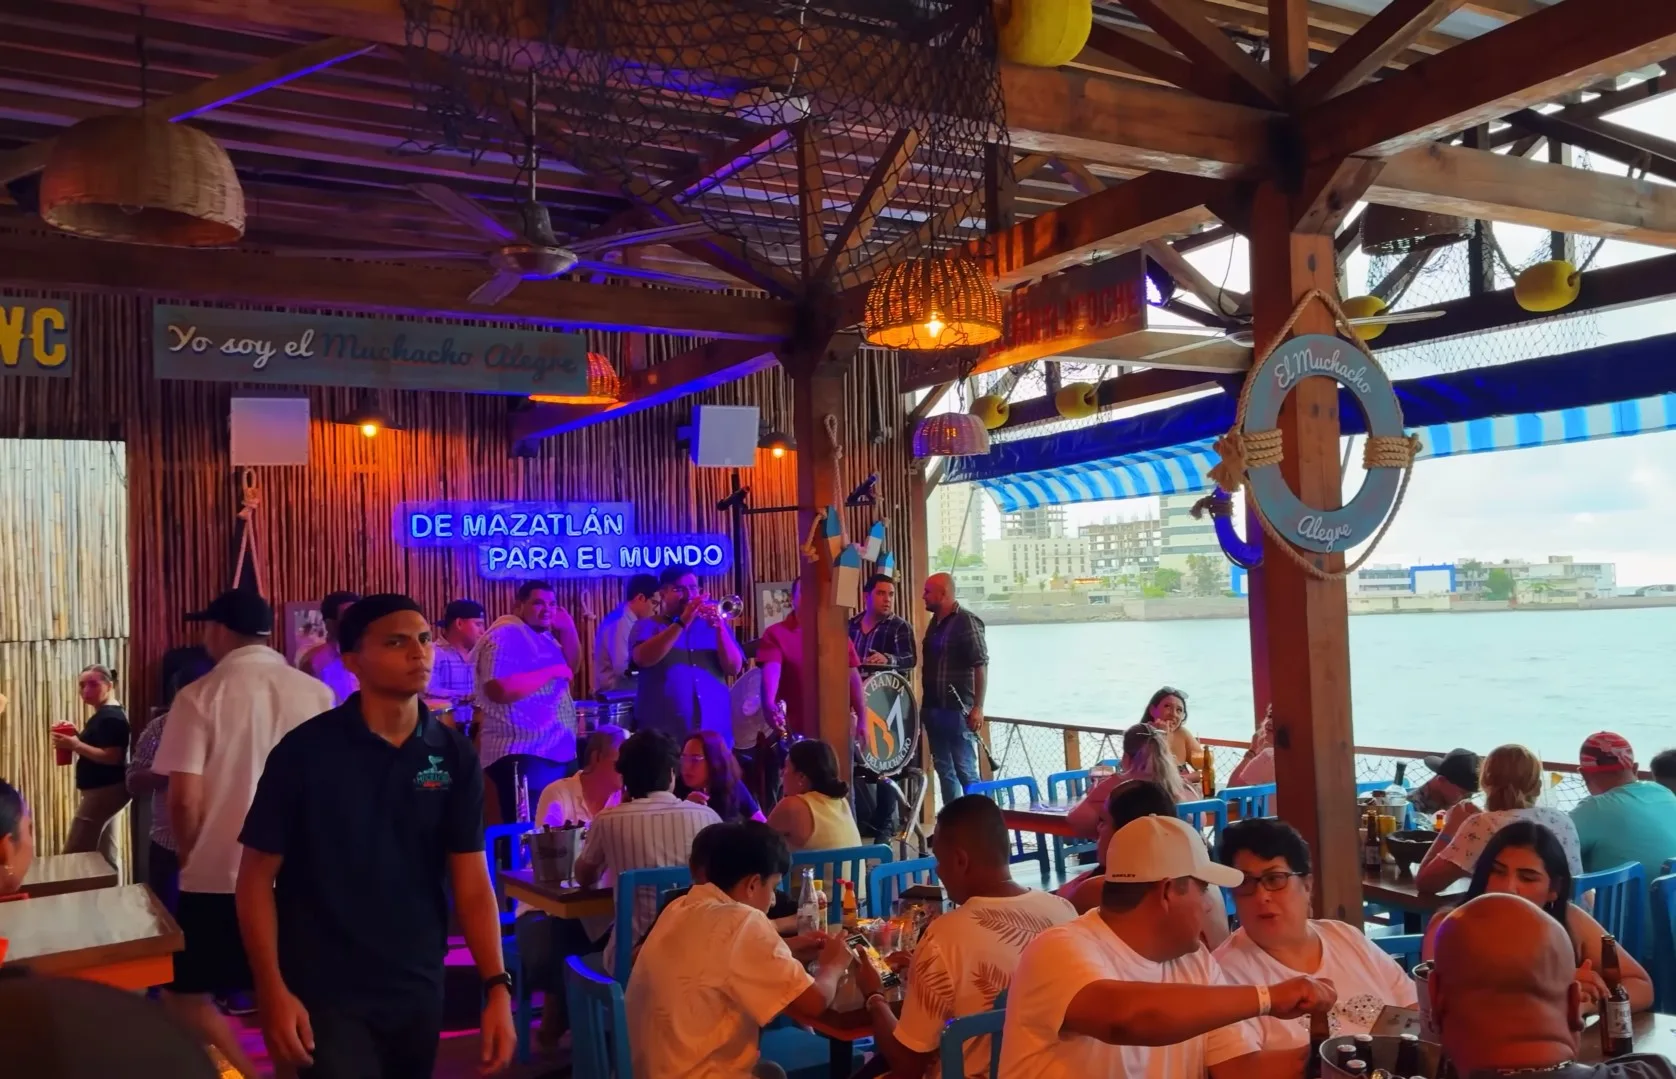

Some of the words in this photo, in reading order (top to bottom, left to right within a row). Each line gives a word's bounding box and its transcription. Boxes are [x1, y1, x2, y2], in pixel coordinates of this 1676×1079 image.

[167, 324, 213, 351] Yo
[220, 337, 276, 369] soy
[284, 328, 315, 357] el
[321, 332, 473, 366] Muchacho
[484, 344, 577, 381] Alegre
[1274, 356, 1295, 389] El
[1295, 348, 1371, 394] Muchacho
[411, 513, 453, 538] DE
[462, 507, 624, 537] MAZATLÁN
[1297, 515, 1352, 552] Alegre
[489, 546, 569, 570] PARA
[577, 546, 612, 570] EL
[620, 544, 724, 569] MUNDO
[871, 675, 905, 696] BANDA
